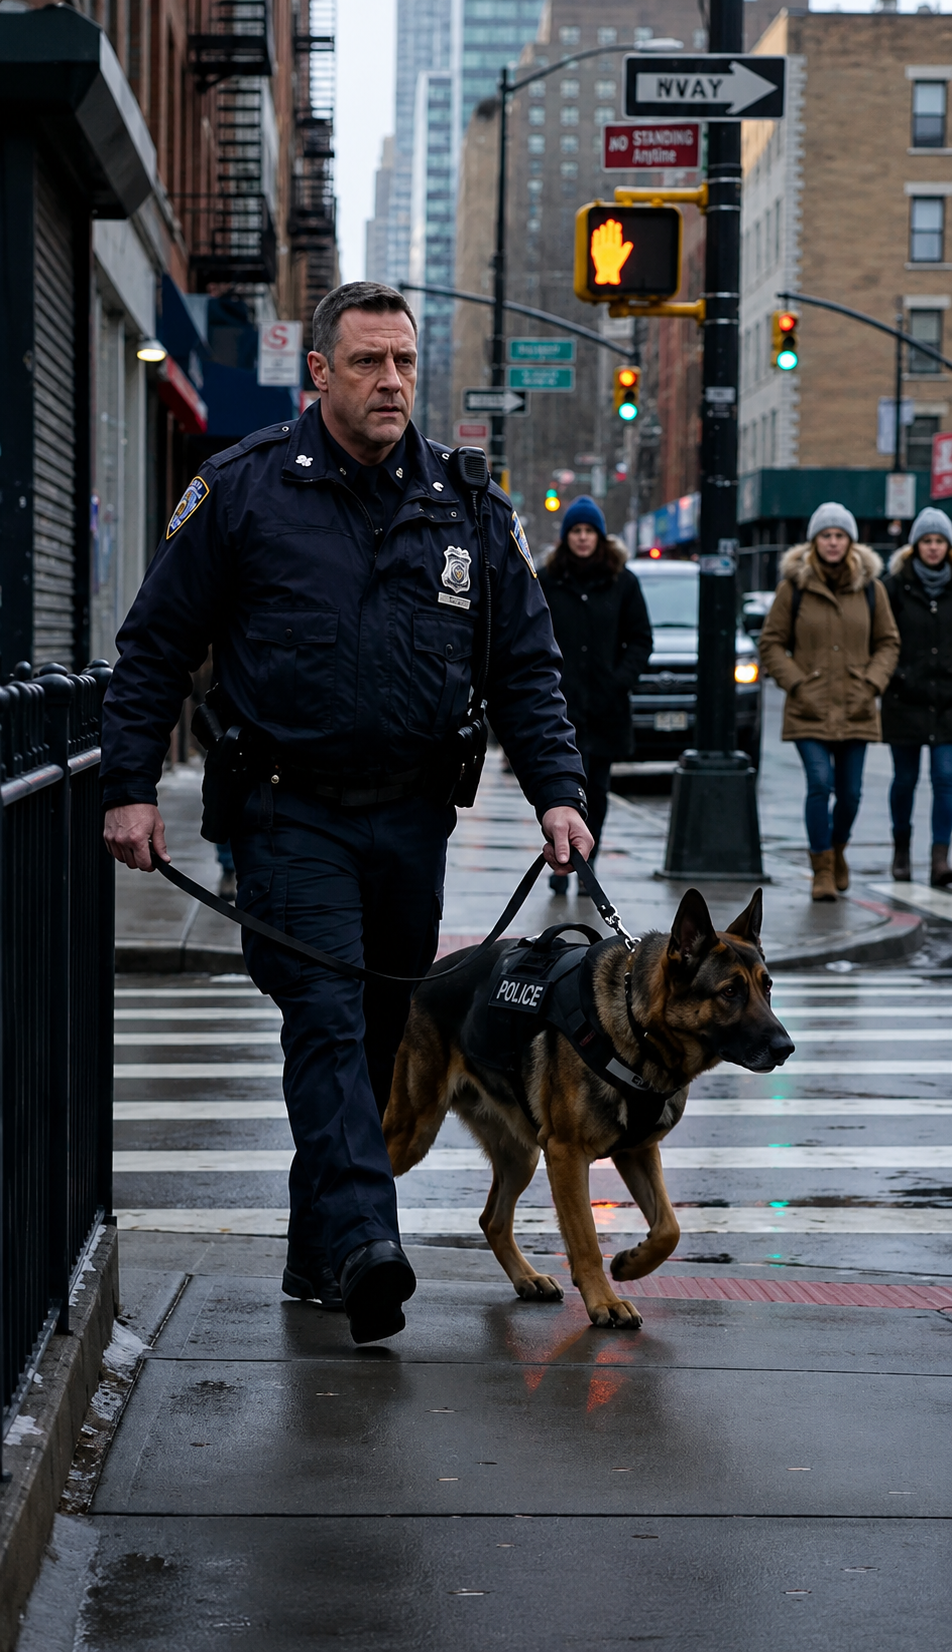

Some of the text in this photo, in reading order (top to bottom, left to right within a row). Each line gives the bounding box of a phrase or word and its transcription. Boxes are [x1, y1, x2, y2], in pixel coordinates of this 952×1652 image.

[609, 129, 694, 152] NO STANDING
[496, 980, 544, 1007] POLICE
